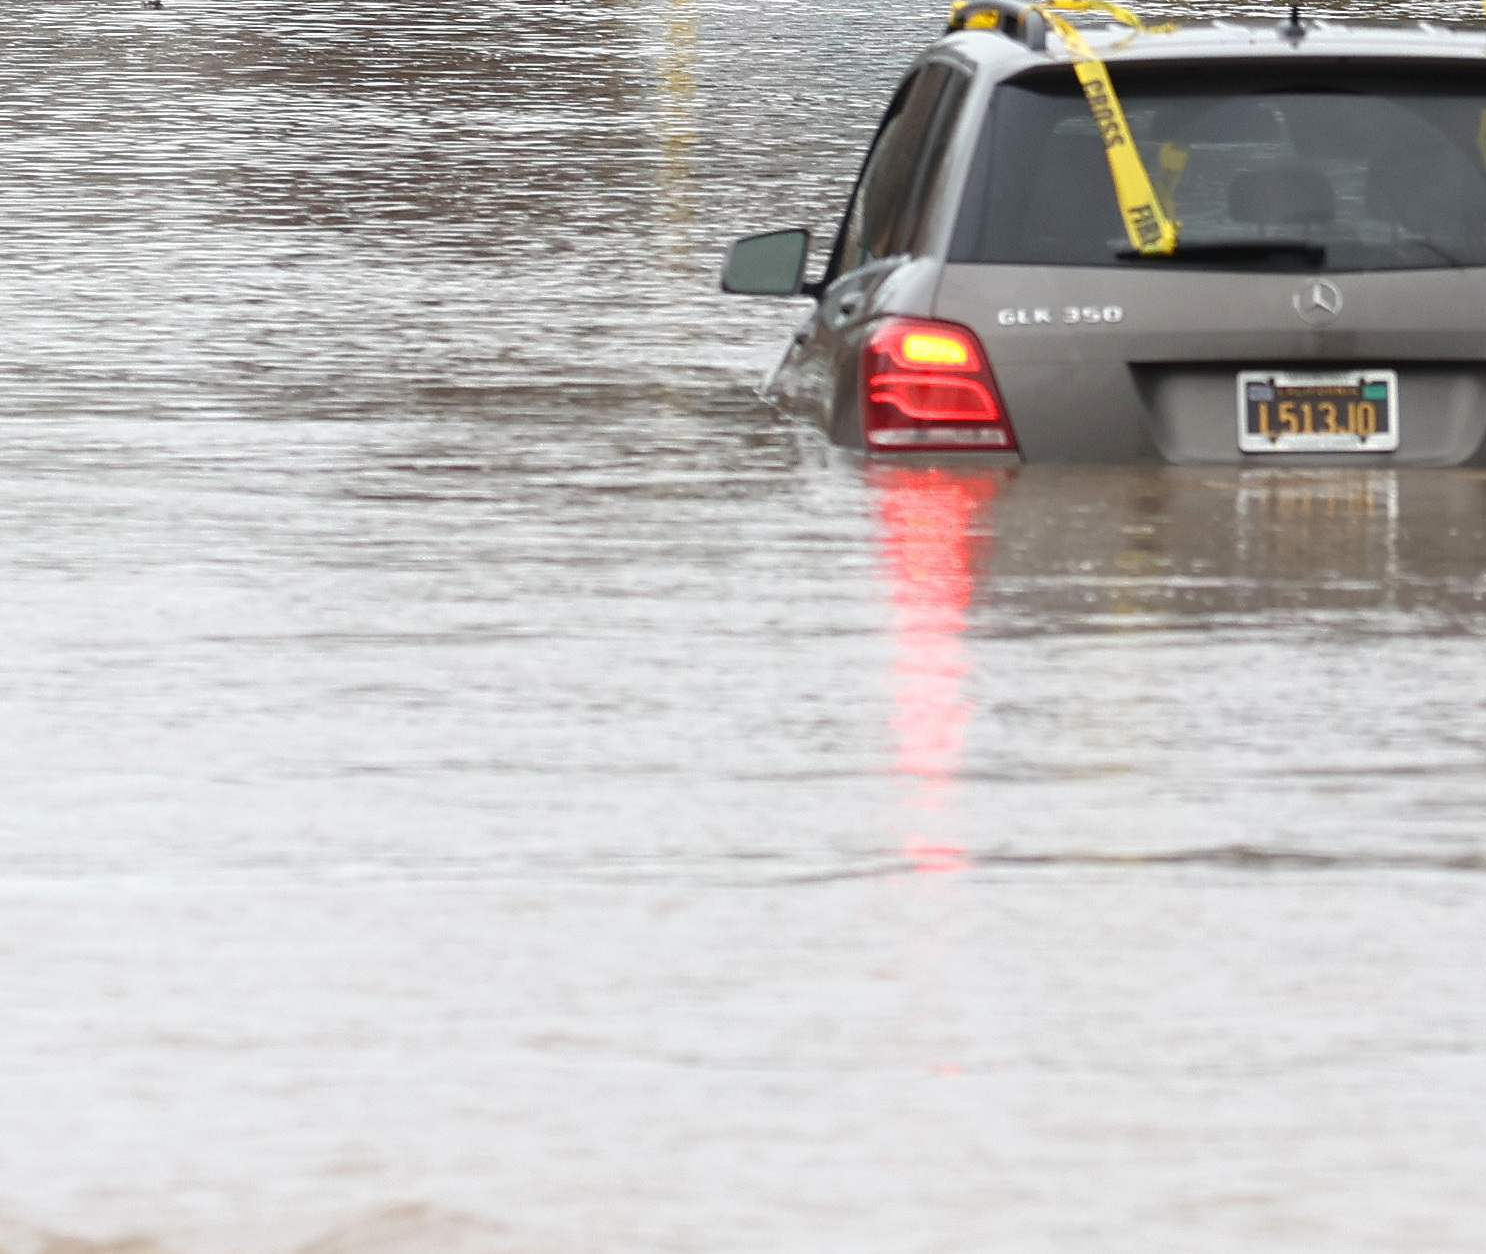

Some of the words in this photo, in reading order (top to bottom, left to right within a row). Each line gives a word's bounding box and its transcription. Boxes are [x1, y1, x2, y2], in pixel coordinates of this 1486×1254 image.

[1083, 79, 1124, 146] CROSS
[998, 308, 1051, 326] GLK
[1062, 306, 1123, 324] 350
